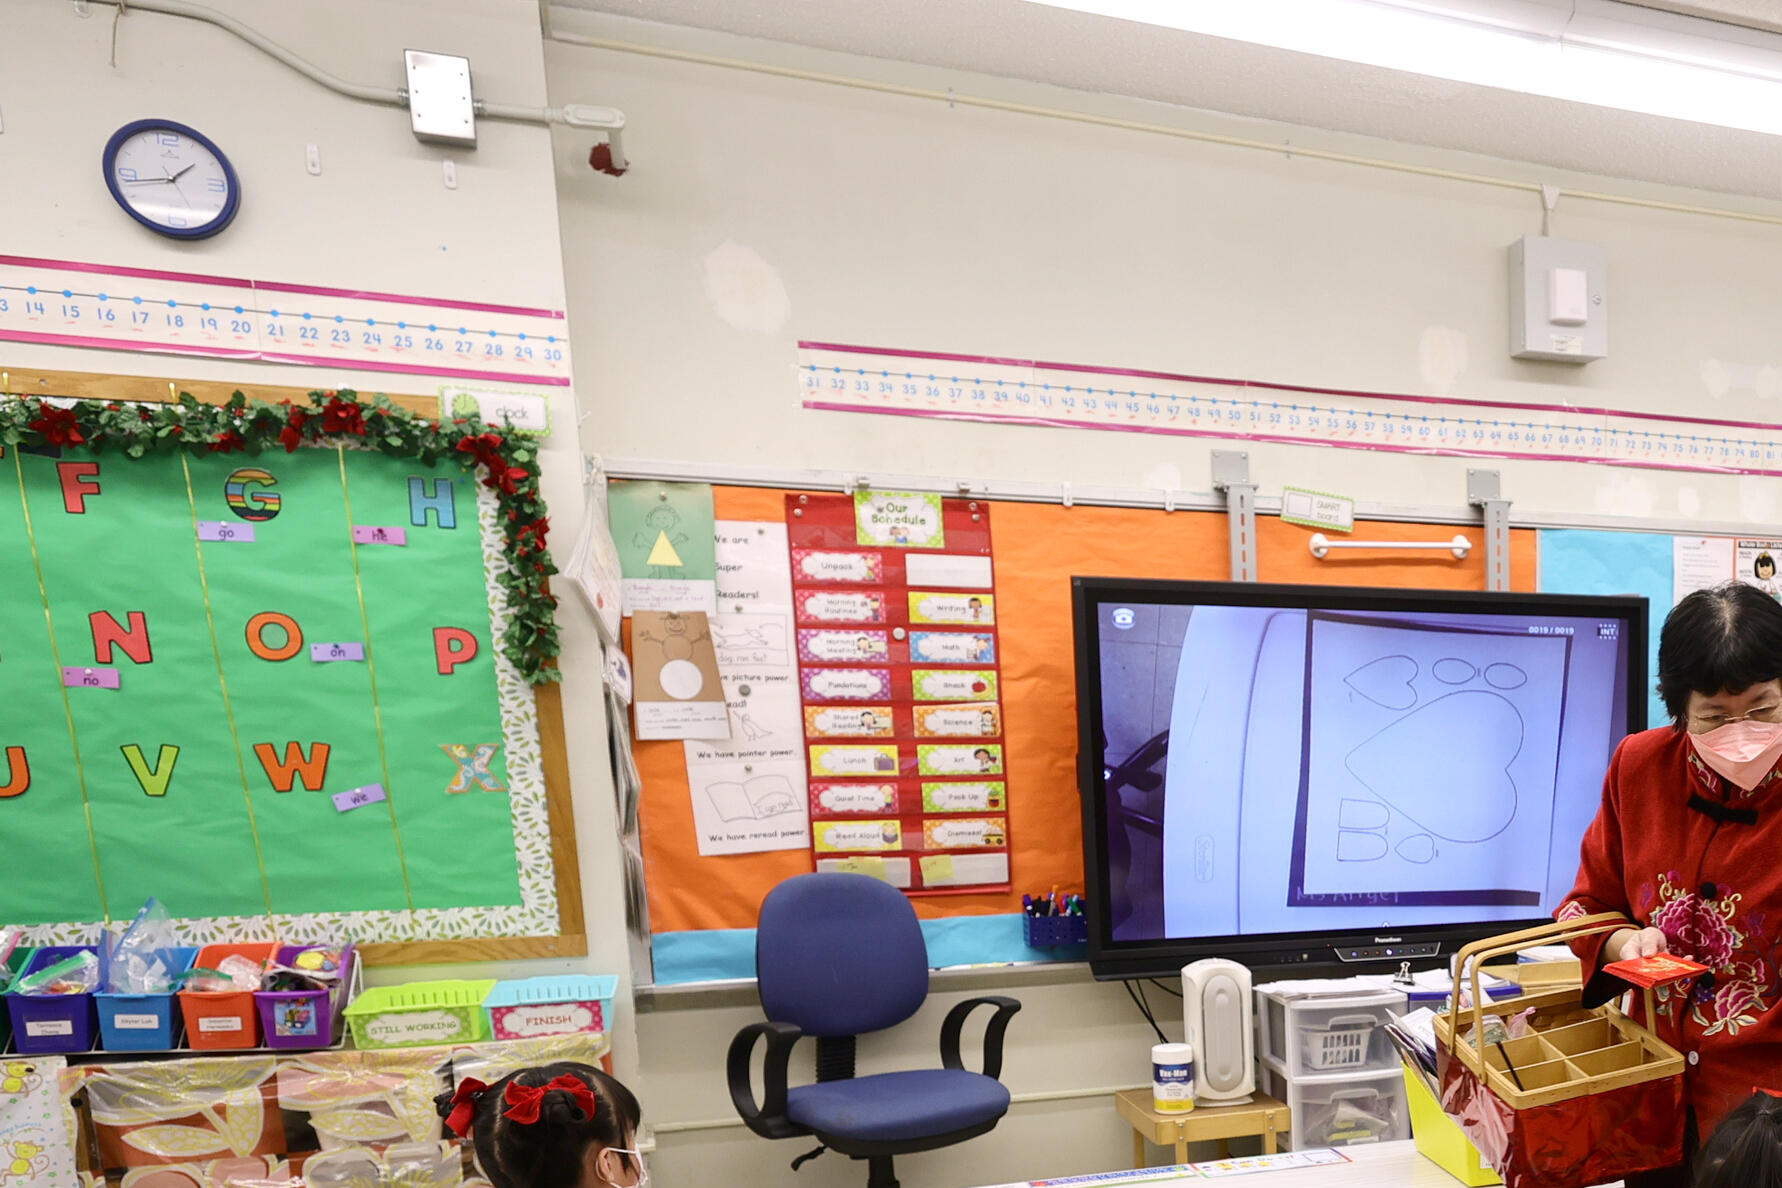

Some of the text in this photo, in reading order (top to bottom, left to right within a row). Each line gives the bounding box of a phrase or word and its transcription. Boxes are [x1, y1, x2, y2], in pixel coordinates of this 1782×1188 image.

[156, 132, 180, 147] 12
[26, 302, 562, 361] 14 16 18 20 22 24 26 30
[56, 462, 100, 513] F
[225, 468, 281, 521] G
[407, 475, 456, 529] H
[886, 502, 908, 514] Our
[1317, 500, 1340, 510] SMART
[218, 529, 235, 541] go
[872, 514, 926, 526] Schedule
[88, 610, 153, 663] N
[245, 611, 303, 661] O
[432, 627, 478, 675] P
[83, 675, 100, 687] no
[120, 743, 180, 797] V
[253, 740, 331, 793] W
[439, 743, 507, 794] X
[371, 1021, 456, 1034] STILL WORKING
[526, 1015, 572, 1027] FINISH
